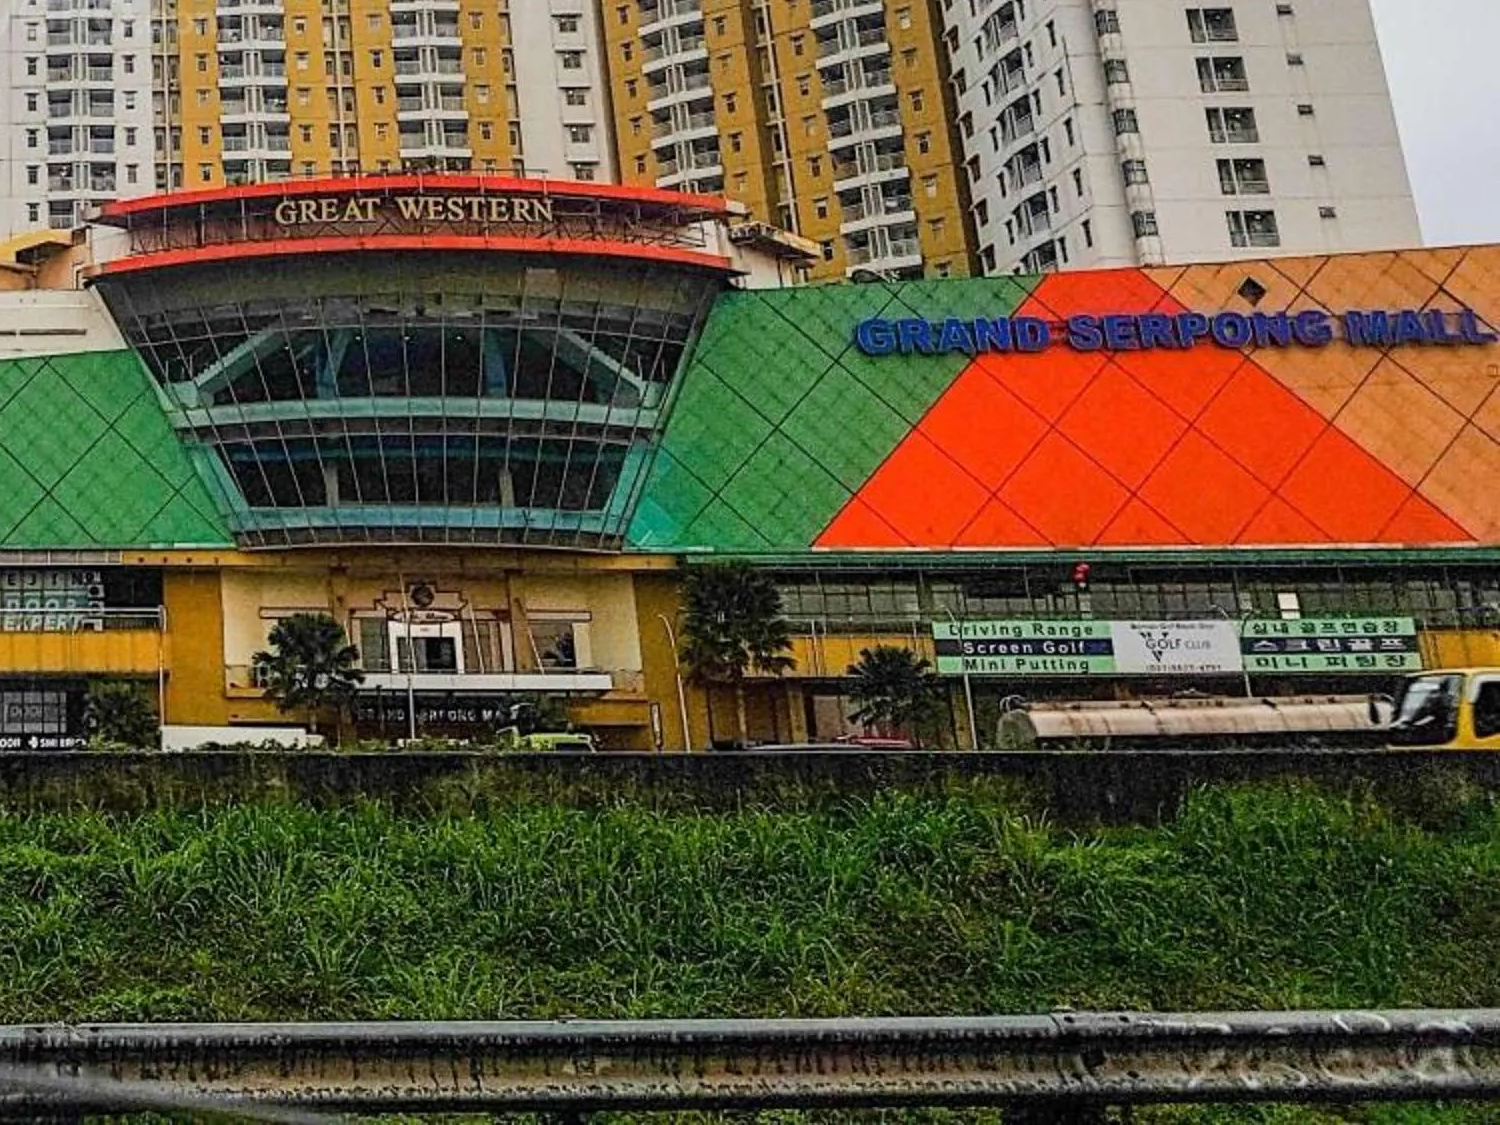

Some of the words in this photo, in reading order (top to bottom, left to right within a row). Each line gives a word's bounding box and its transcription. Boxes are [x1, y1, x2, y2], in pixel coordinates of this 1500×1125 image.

[275, 197, 380, 224] GREAT
[396, 196, 553, 222] WESTERN
[856, 315, 1050, 355] GRAND
[1067, 312, 1330, 351] SERPONG
[1343, 308, 1498, 346] MALL
[949, 624, 1024, 637] Driving
[1033, 623, 1093, 637] Range
[963, 641, 1033, 654] Screen
[1043, 640, 1085, 654] Golf
[1146, 638, 1181, 650] GOLF
[964, 658, 1006, 671] Mini
[1016, 658, 1090, 673] Putting
[1255, 656, 1308, 669] 미니
